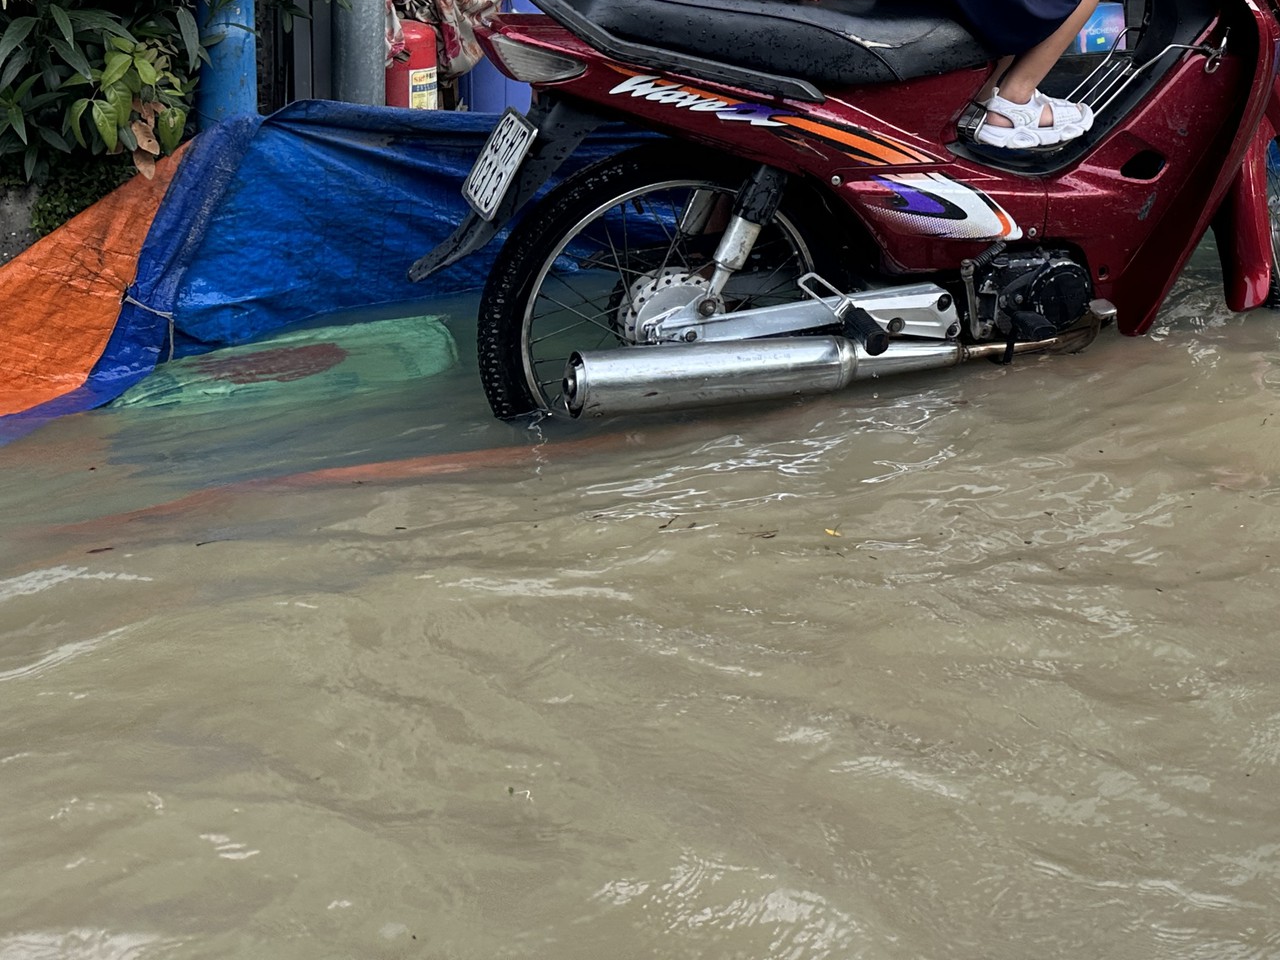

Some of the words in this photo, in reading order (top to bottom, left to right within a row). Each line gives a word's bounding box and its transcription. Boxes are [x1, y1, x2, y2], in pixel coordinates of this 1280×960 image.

[609, 75, 738, 111] Wave
[490, 116, 527, 166] 63-H7
[470, 155, 503, 209] 0313
